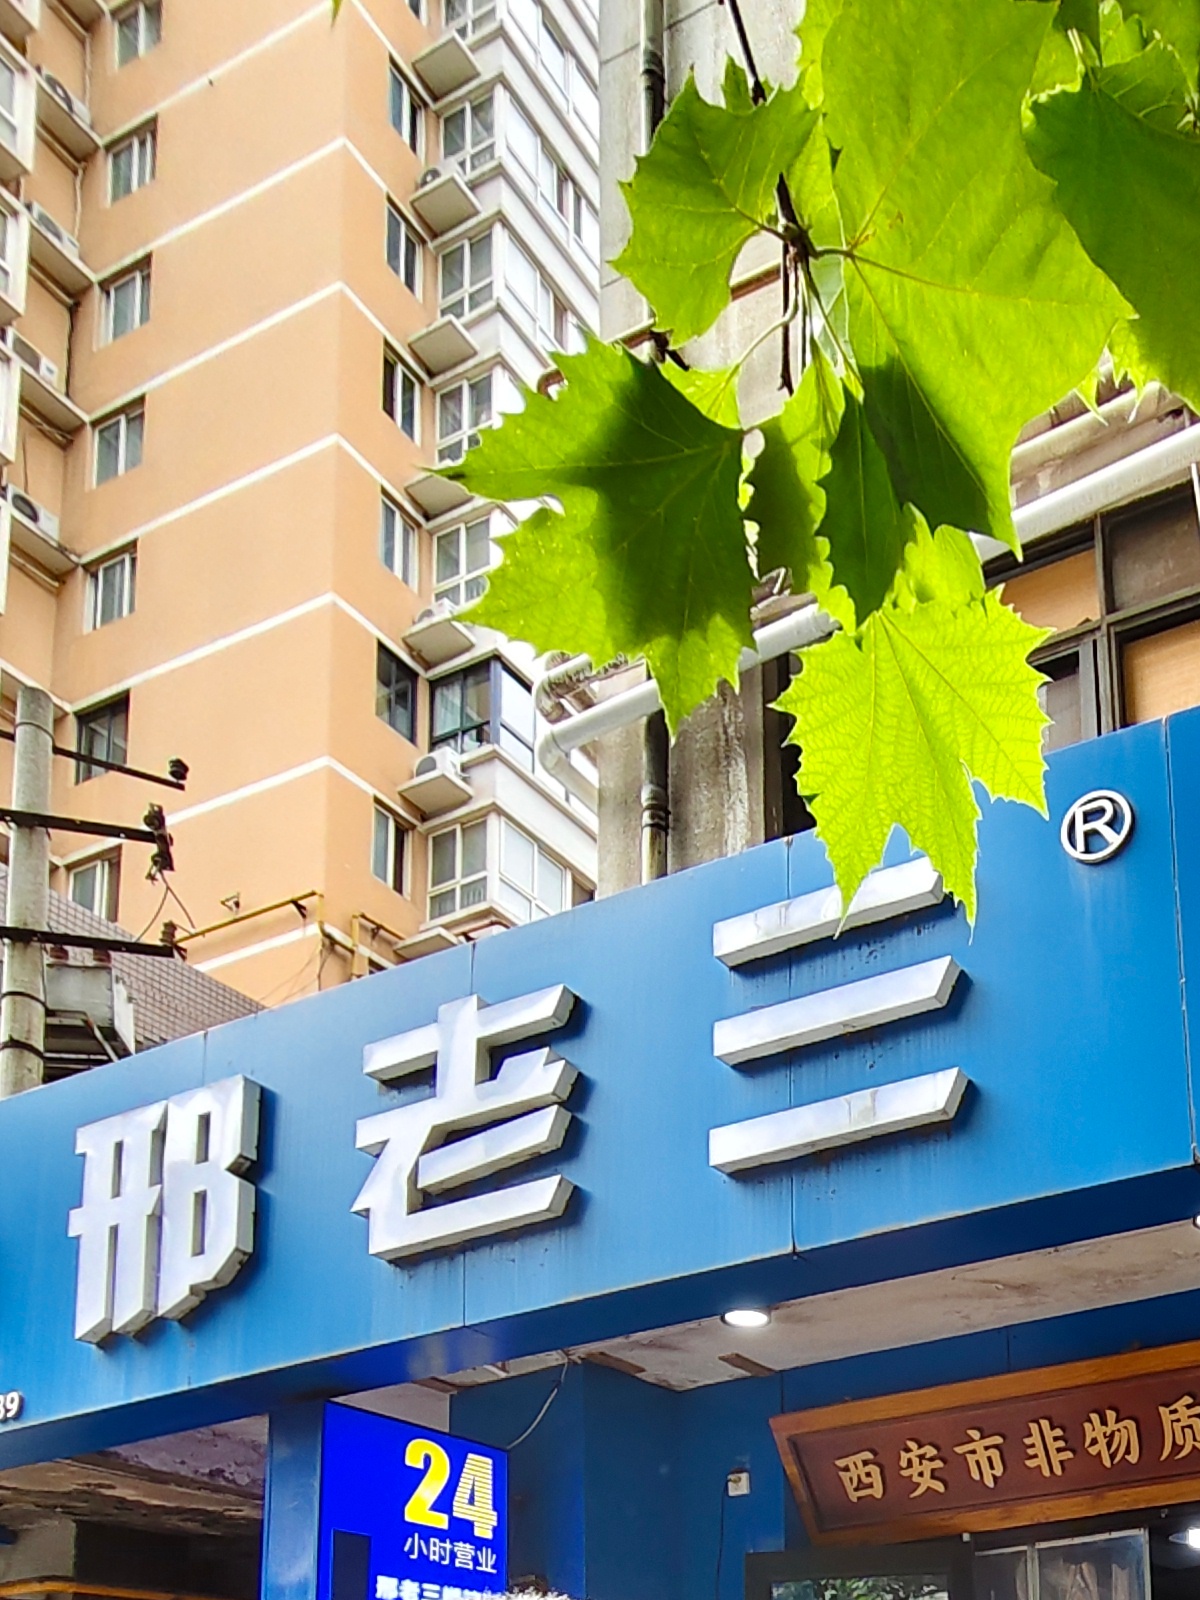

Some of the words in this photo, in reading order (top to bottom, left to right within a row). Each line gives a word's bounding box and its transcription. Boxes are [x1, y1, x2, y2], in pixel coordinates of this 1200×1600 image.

[68, 857, 970, 1344] 邢老三
[404, 1438, 498, 1540] 24
[403, 1532, 498, 1574] 小时营业
